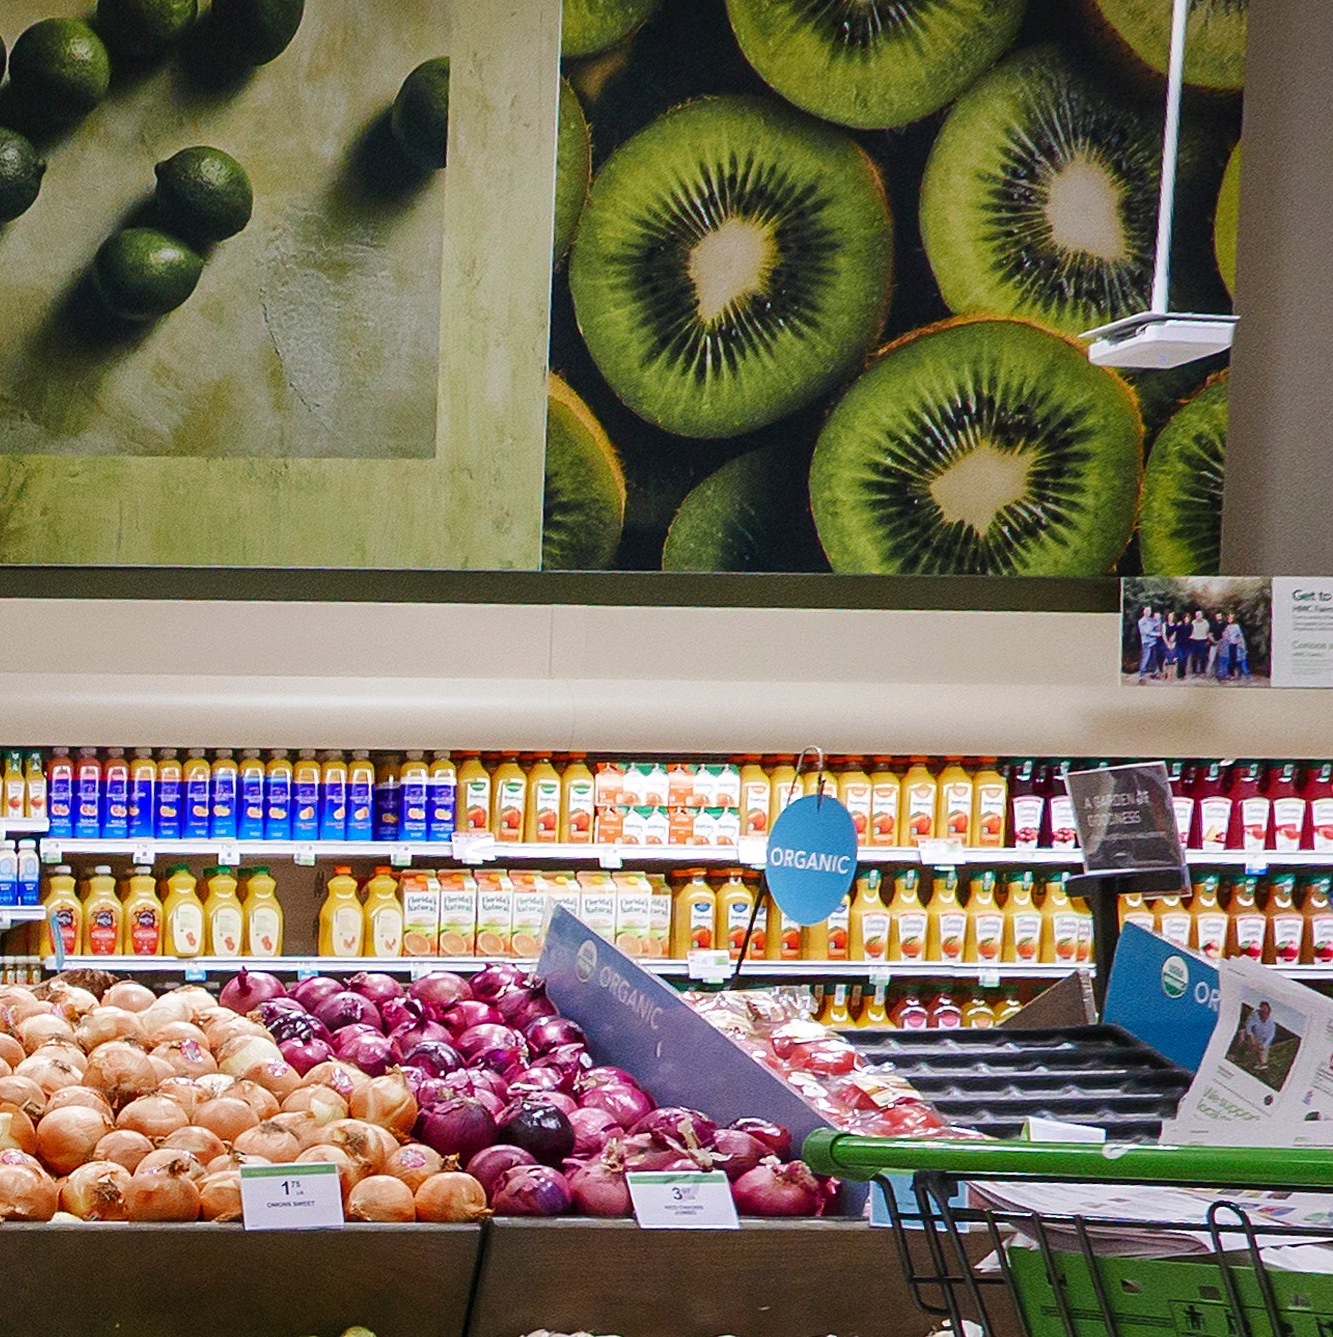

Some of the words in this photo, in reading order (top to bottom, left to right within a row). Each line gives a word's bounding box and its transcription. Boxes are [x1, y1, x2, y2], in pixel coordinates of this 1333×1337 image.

[1293, 589, 1315, 601] Get
[1319, 591, 1332, 601] to
[770, 847, 851, 875] ORGANIC
[599, 966, 663, 1030] ORGANIC
